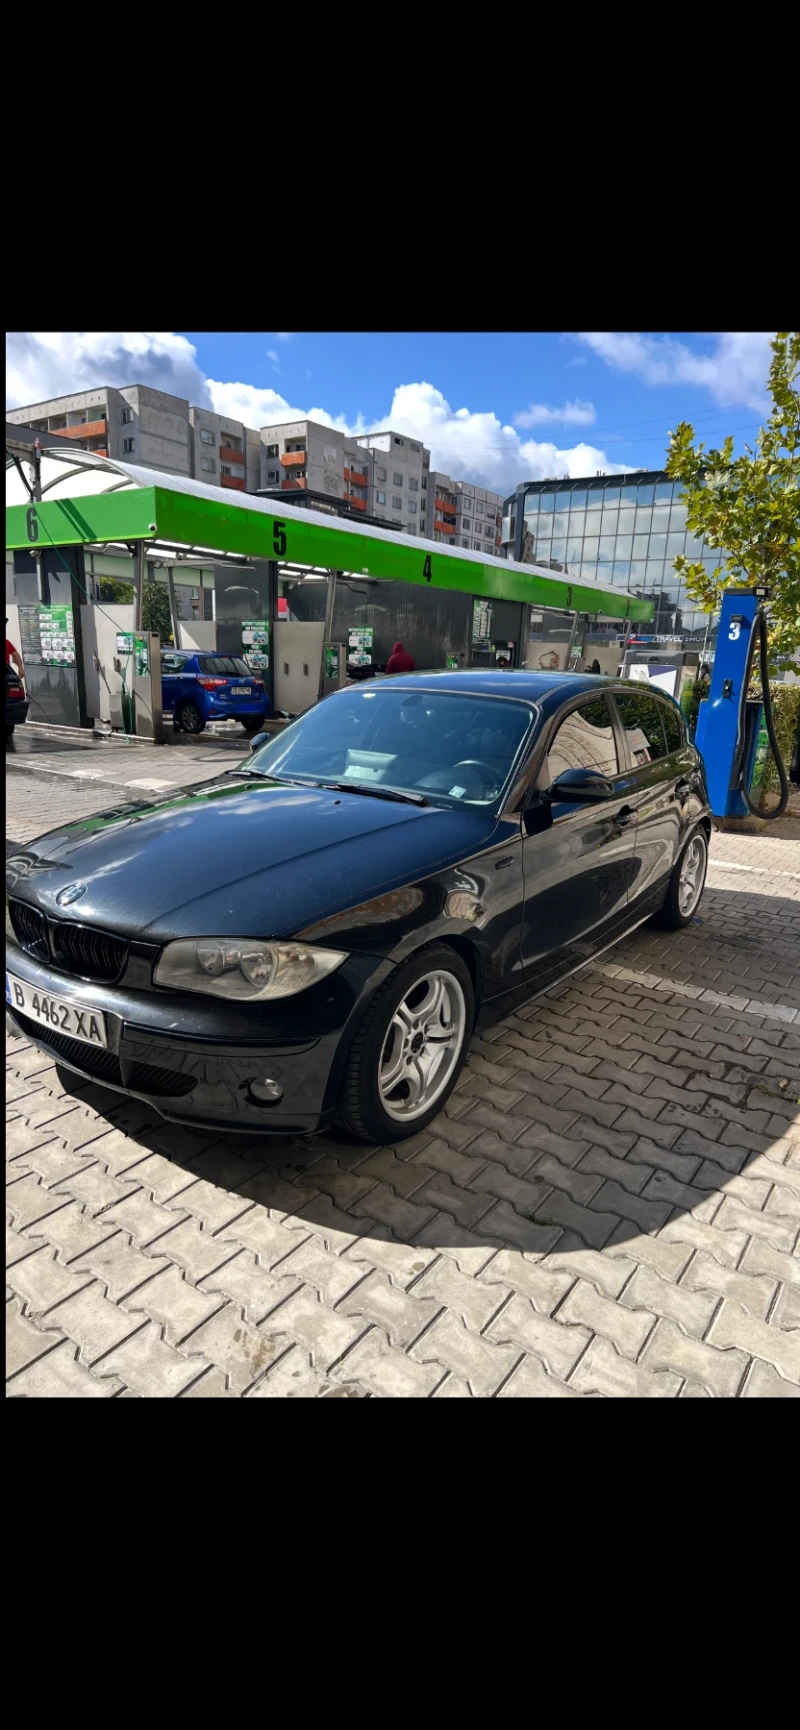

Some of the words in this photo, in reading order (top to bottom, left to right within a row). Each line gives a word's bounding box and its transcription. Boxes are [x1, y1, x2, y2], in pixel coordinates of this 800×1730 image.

[26, 508, 38, 542] 6
[273, 521, 287, 556] 5
[423, 555, 432, 582] 4
[566, 586, 572, 607] 3
[626, 600, 631, 617] 2
[729, 623, 741, 640] 3
[13, 982, 25, 1007] B
[32, 994, 71, 1031] 4462
[74, 1009, 101, 1041] XA
